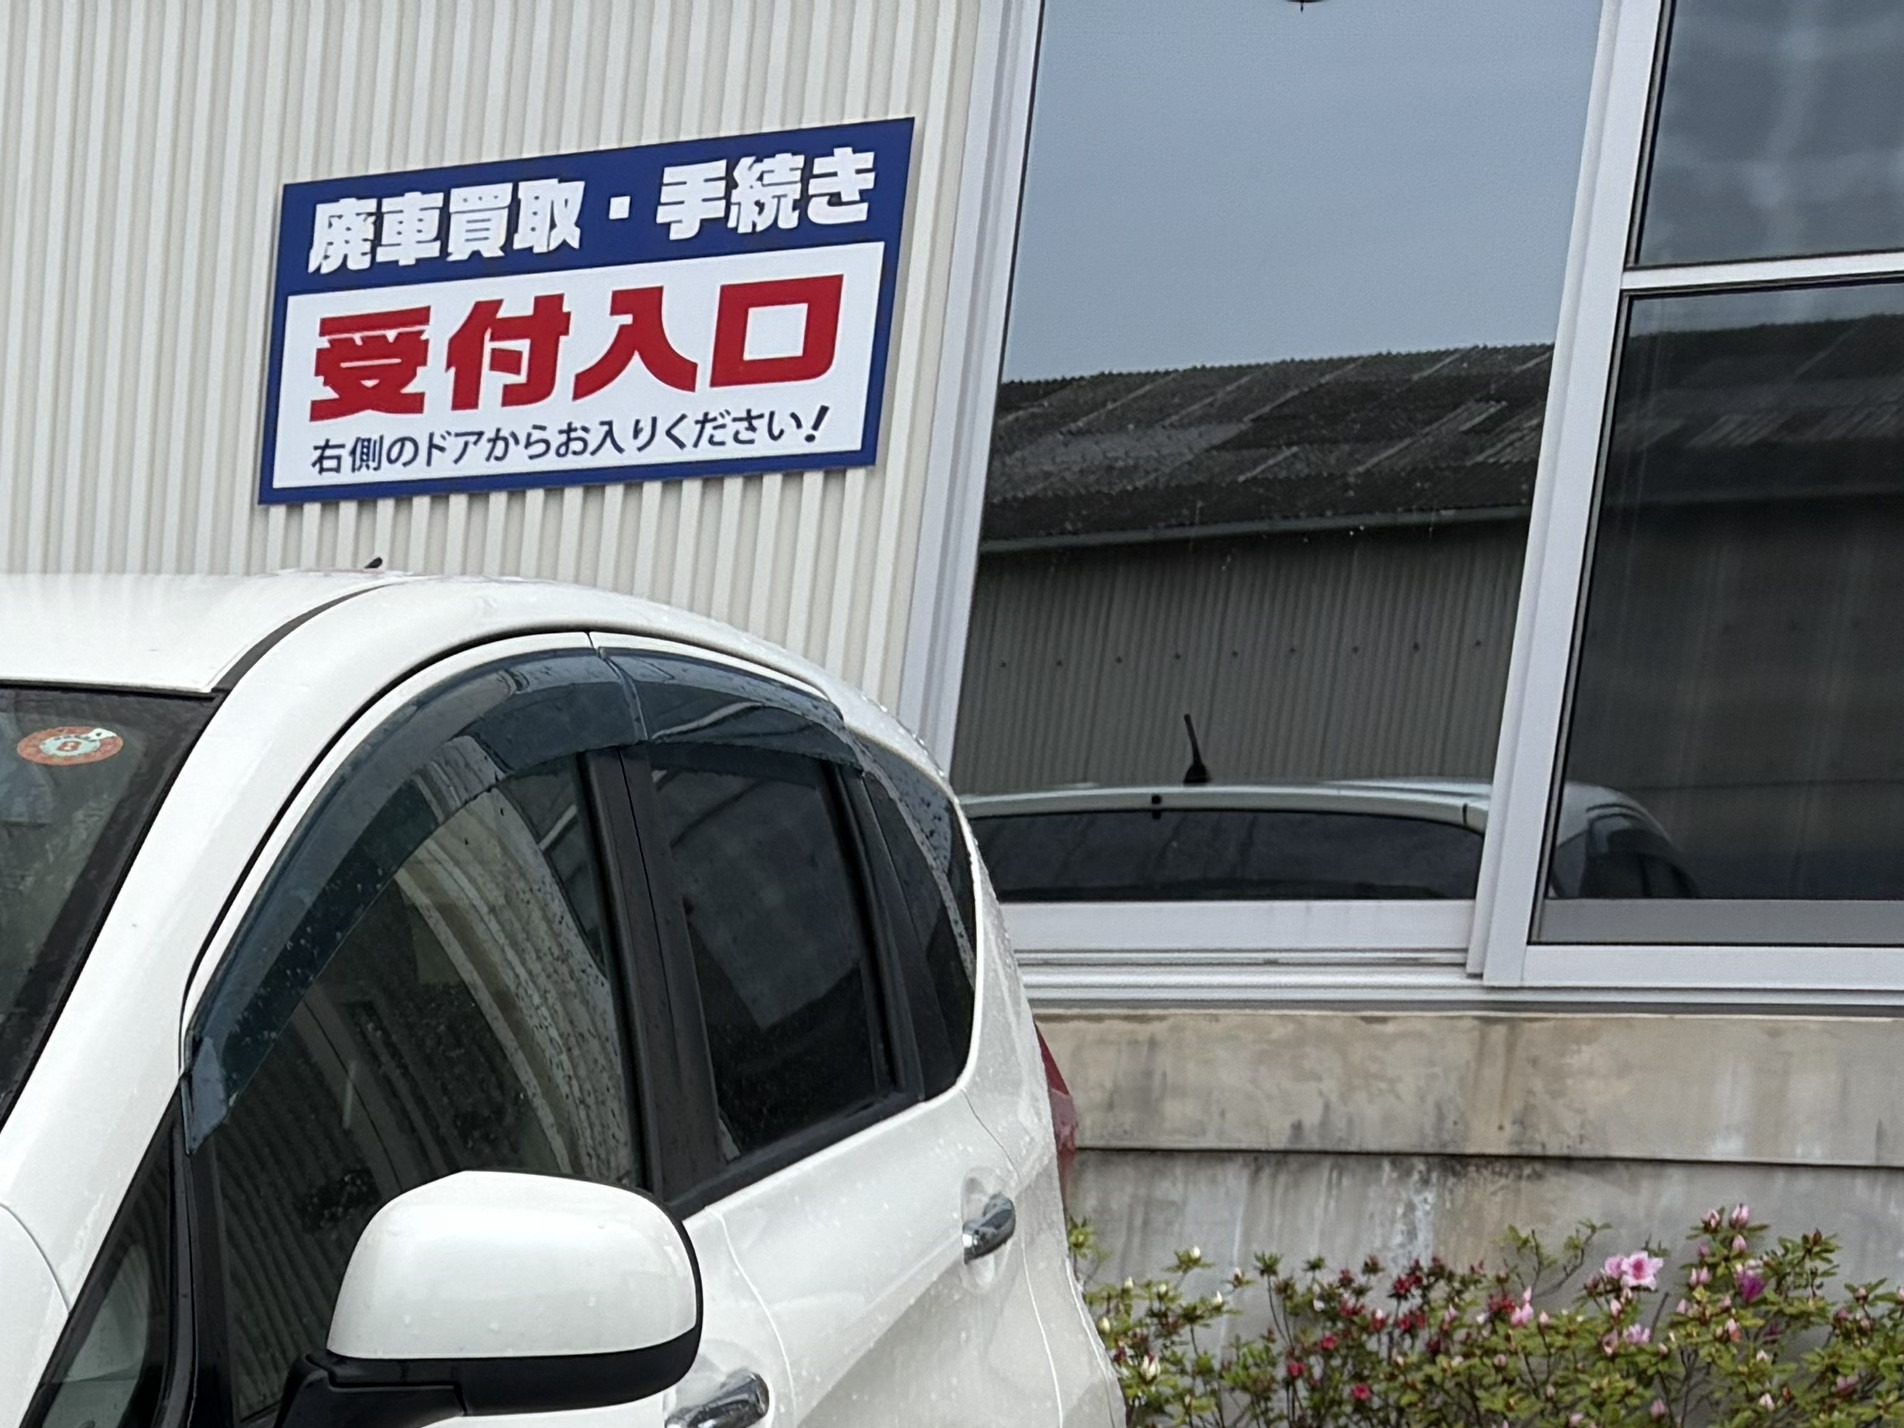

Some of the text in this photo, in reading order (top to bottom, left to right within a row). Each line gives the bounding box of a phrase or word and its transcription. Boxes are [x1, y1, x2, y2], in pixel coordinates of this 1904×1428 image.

[308, 147, 875, 274] 廃車買取・手続き
[309, 274, 845, 422] 受付入口
[311, 405, 830, 475] 右側のドアからお入りください！
